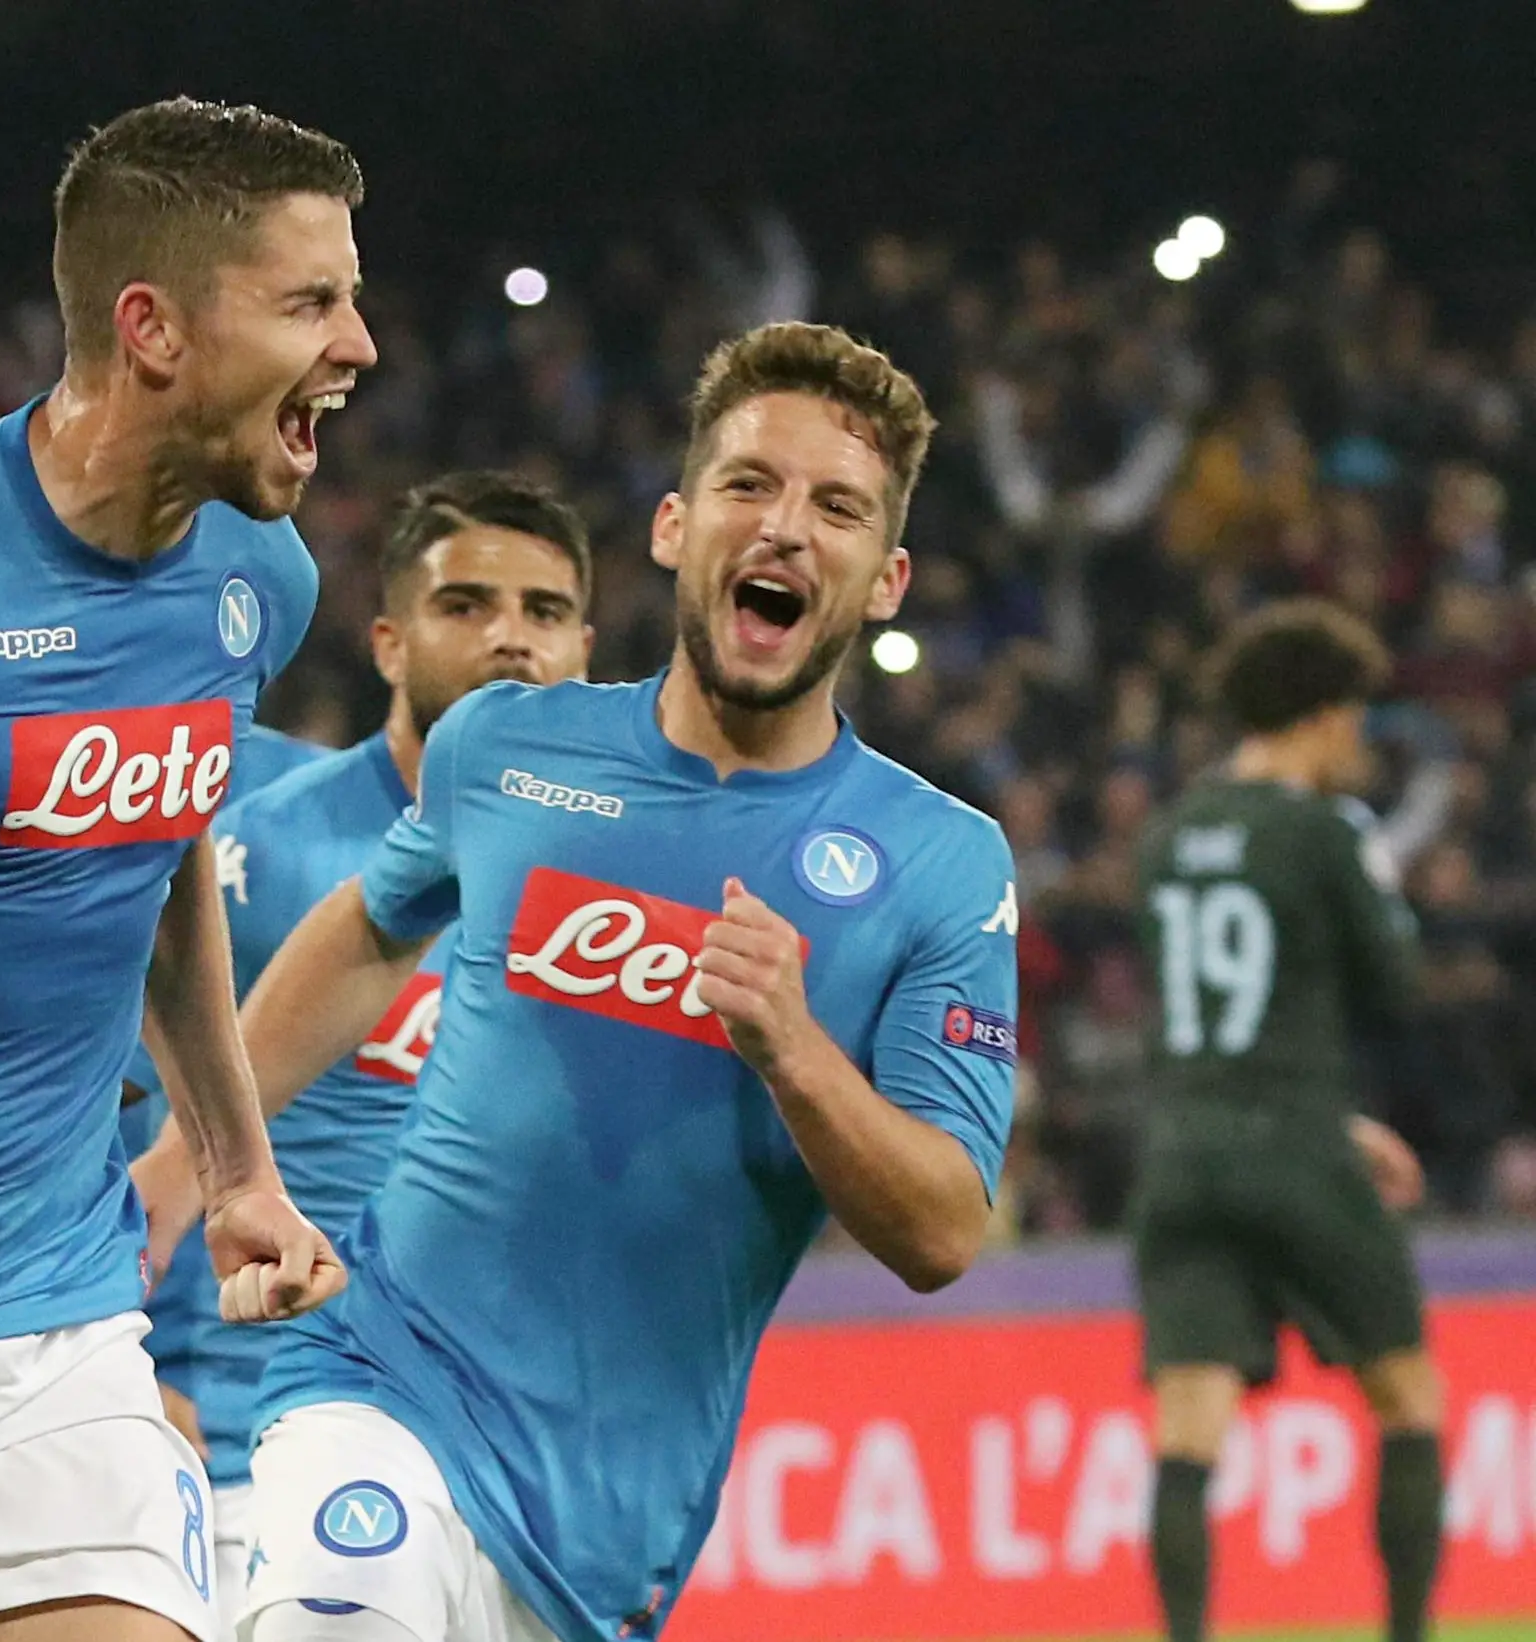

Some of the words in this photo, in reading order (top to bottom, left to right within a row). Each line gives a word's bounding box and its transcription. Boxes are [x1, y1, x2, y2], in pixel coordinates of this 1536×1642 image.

[225, 593, 249, 643] N
[2, 724, 232, 836] Lete
[500, 768, 624, 818] Kappa
[816, 840, 866, 887] N
[1152, 881, 1277, 1056] 19
[175, 1468, 211, 1603] 8
[335, 1498, 386, 1537] N
